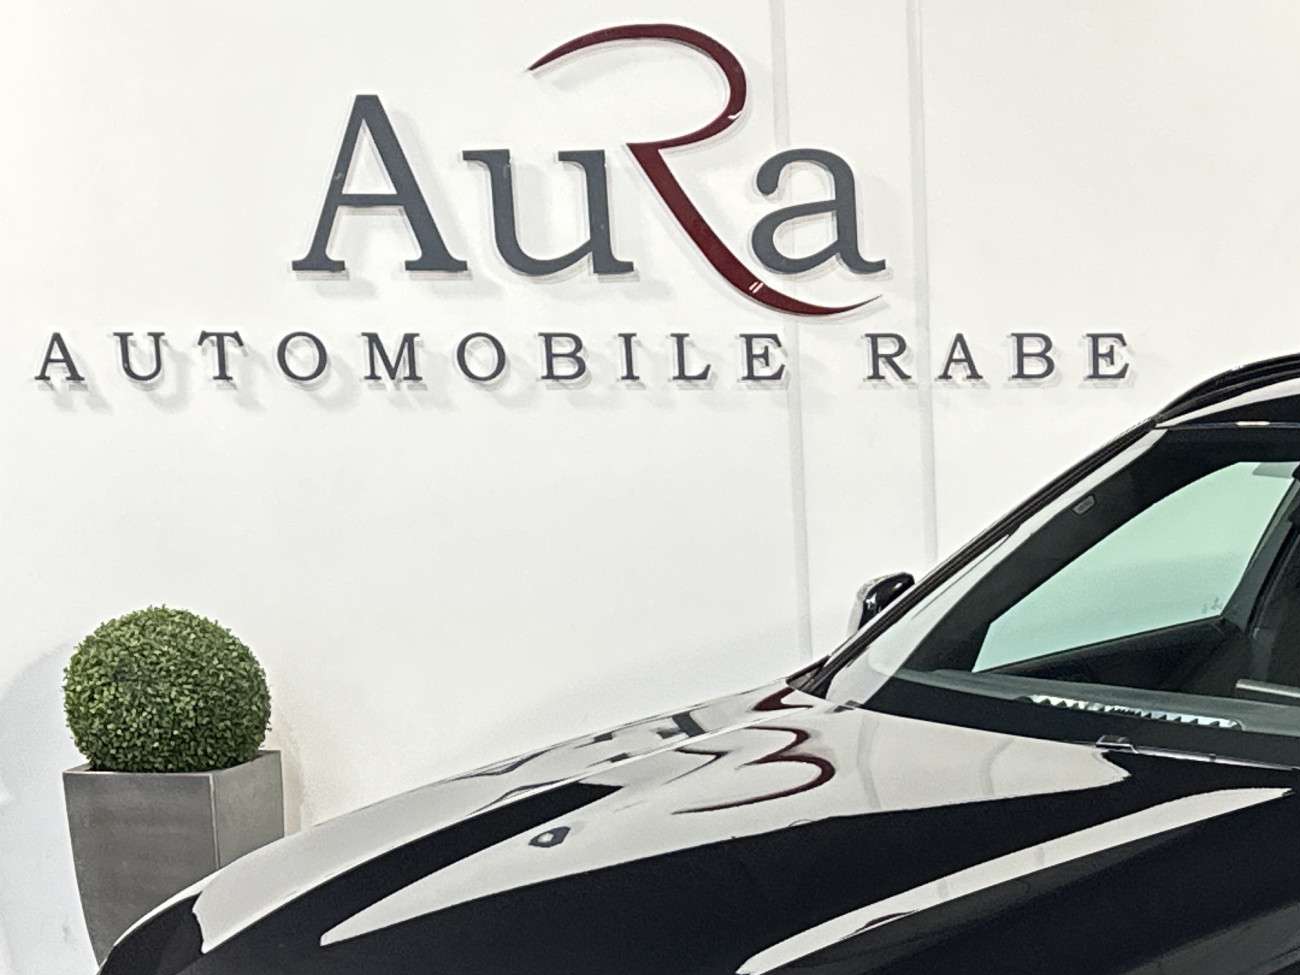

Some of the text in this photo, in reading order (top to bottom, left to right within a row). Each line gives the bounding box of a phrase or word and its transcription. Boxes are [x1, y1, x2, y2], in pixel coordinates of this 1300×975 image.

[292, 23, 887, 317] AuRa
[35, 332, 1130, 382] AUTOMOBILE RABE
